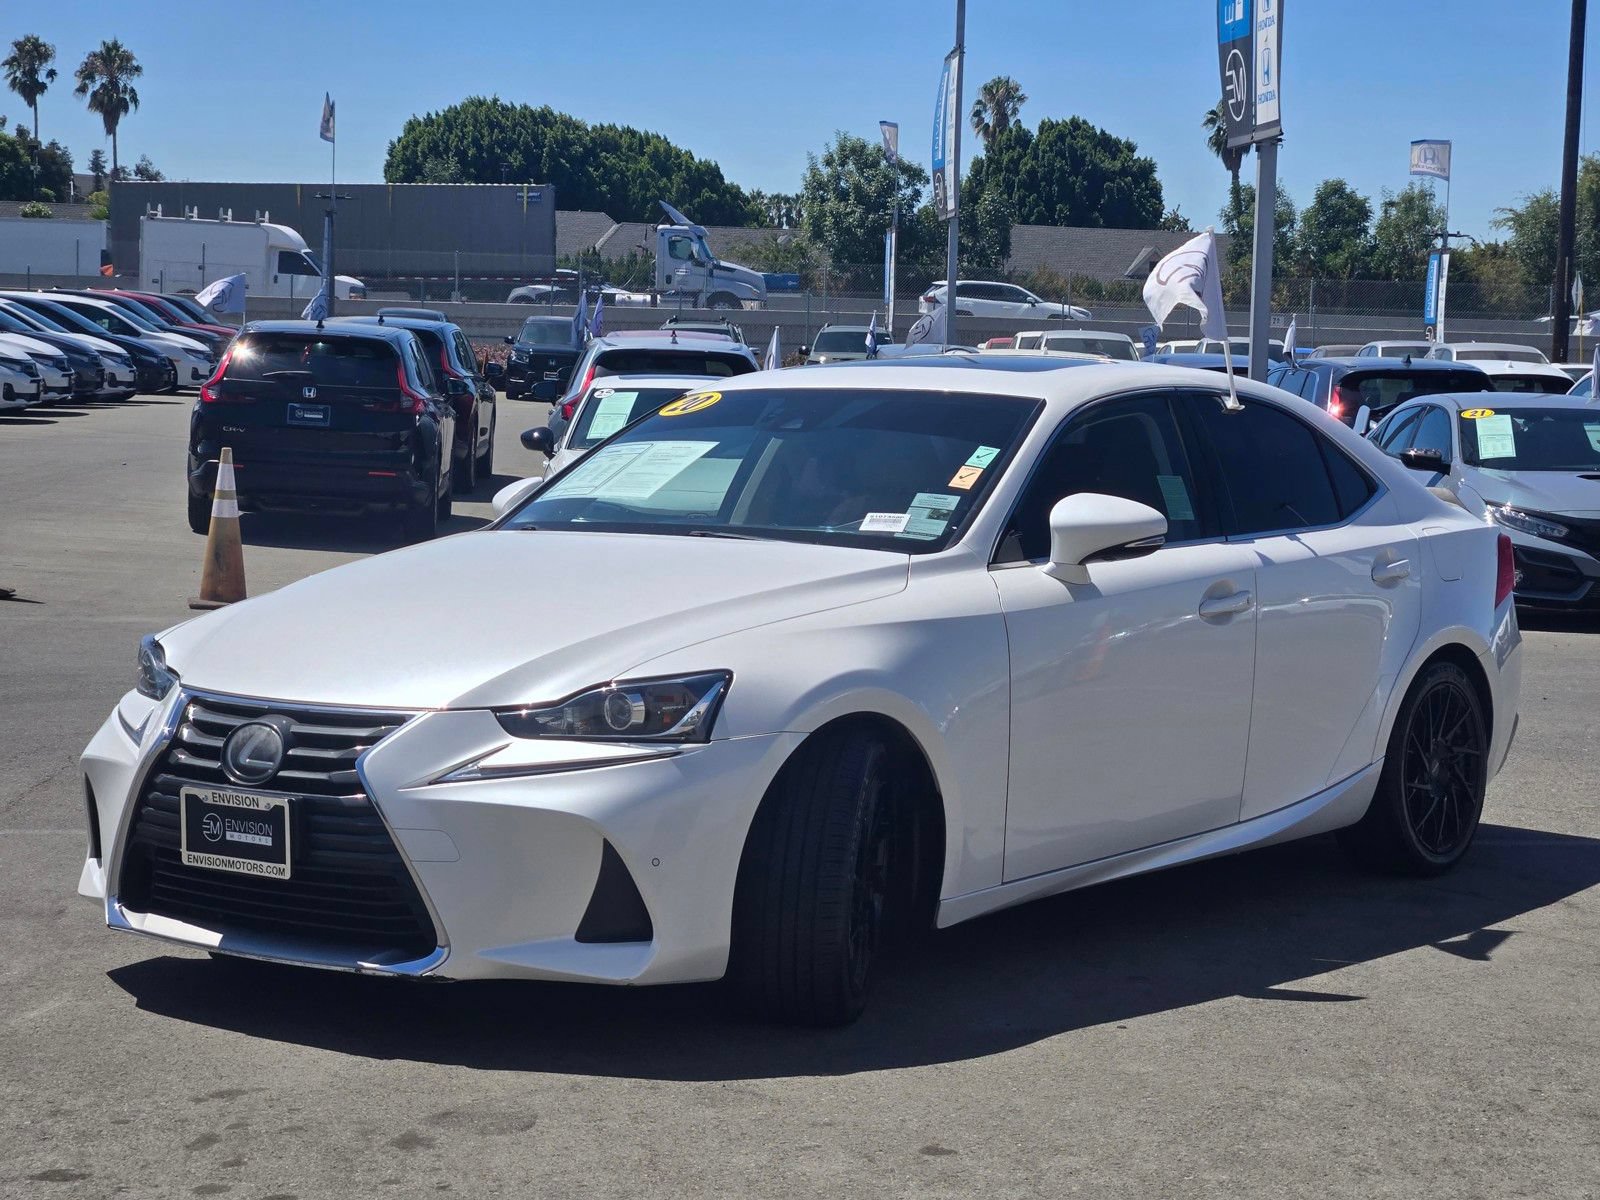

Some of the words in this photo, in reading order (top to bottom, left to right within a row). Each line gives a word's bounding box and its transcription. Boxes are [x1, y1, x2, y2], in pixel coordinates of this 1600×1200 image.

[1257, 15, 1275, 31] HONDA
[1257, 90, 1276, 105] HONDA
[664, 395, 715, 413] 20
[1470, 409, 1486, 417] 21
[211, 792, 260, 808] ENVISION
[225, 818, 273, 836] ENVISION
[229, 833, 270, 844] MOTORS
[187, 854, 286, 877] ENVISIONMOTORS.COM
